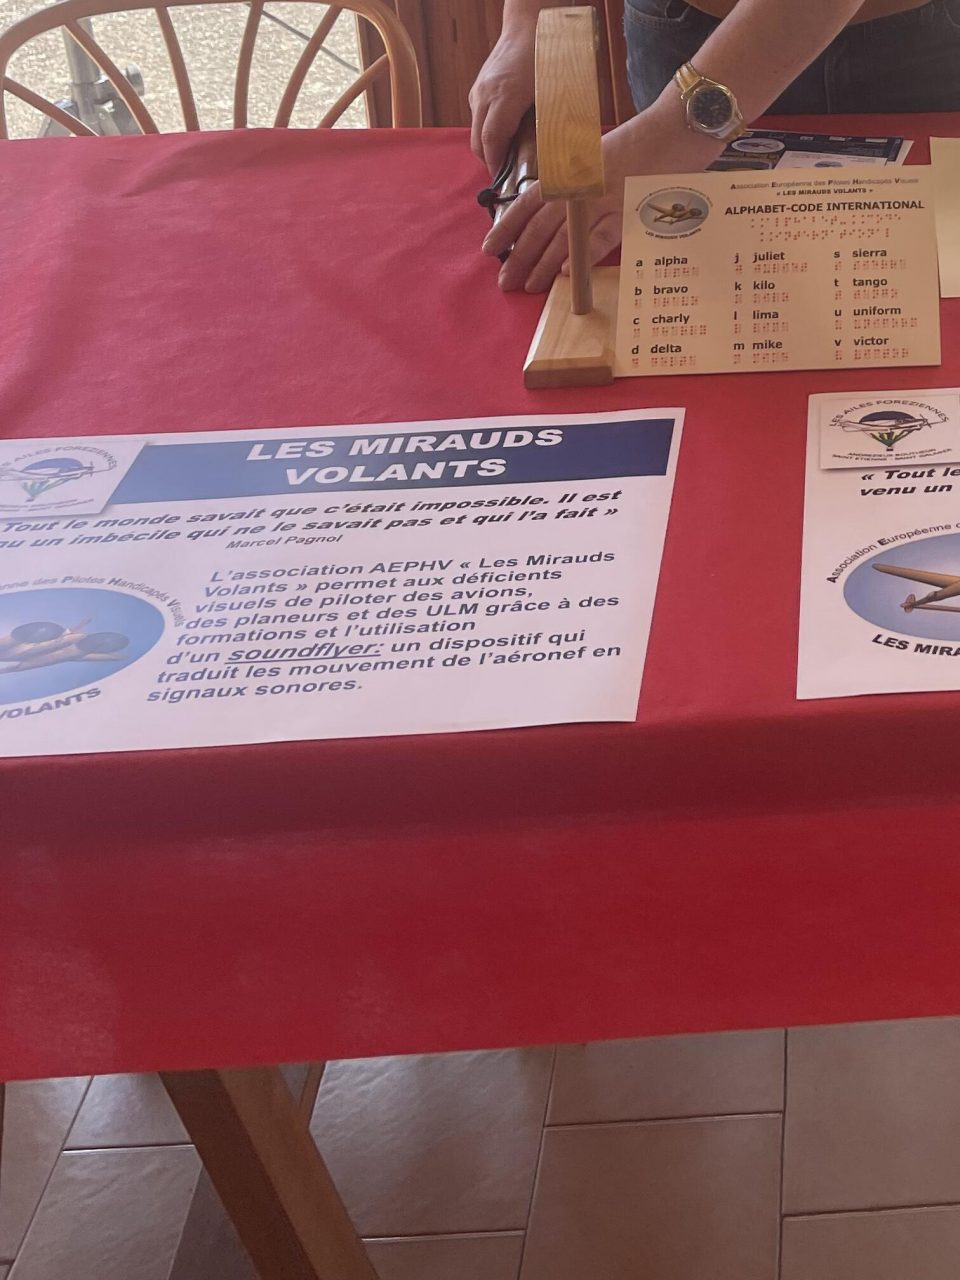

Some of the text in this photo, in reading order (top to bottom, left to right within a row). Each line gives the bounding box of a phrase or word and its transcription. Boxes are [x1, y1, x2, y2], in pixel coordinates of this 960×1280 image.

[725, 201, 925, 215] ALPHABET-CODE INTERNATIONAL
[734, 251, 785, 264] j juliet
[852, 249, 887, 258] sierra
[654, 256, 688, 267] alpha
[735, 280, 775, 291] k kilo
[834, 278, 888, 288] t tango
[635, 285, 688, 296] b bravo
[734, 310, 779, 320] l lima
[835, 306, 901, 317] u uniform
[652, 313, 690, 324] charly
[752, 340, 782, 350] mike
[854, 336, 889, 346] victor
[632, 344, 682, 355] d delta
[829, 400, 949, 427] LES AILES FOREZIENNES
[246, 428, 563, 460] LES MIRAUDS
[287, 459, 507, 486] VOLANTS
[884, 467, 936, 480] Tout
[861, 486, 916, 496] venu
[924, 485, 952, 493] un
[225, 534, 343, 549] Marcel Pagnol
[826, 544, 878, 584] Association
[877, 524, 951, 547] Européenne
[369, 560, 453, 574] AEPHV
[479, 558, 518, 568] Les
[526, 551, 614, 566] Mirauds
[872, 634, 910, 650] LES
